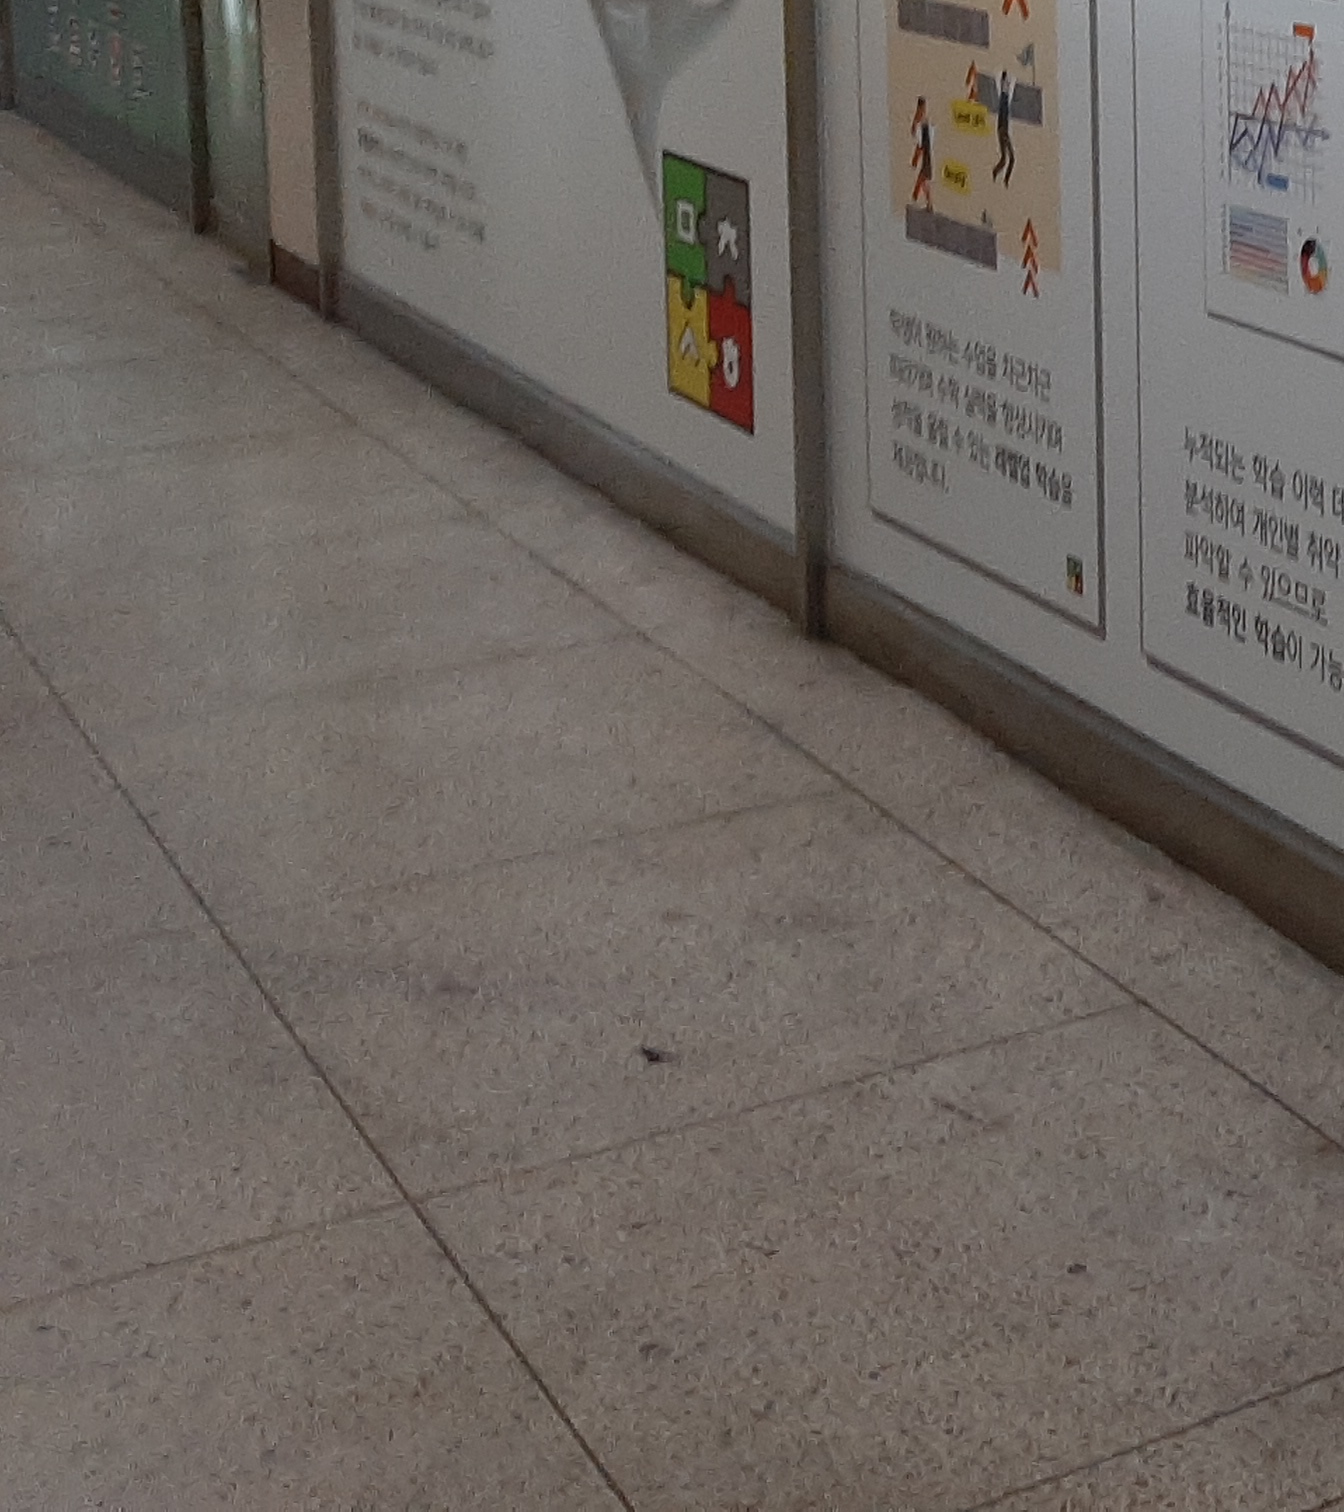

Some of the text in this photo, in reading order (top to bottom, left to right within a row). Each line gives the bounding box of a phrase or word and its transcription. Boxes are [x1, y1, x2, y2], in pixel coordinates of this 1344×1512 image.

[1184, 425, 1245, 485] 누적되는
[1252, 453, 1286, 501] 학습
[1292, 468, 1325, 517] 이력
[1184, 478, 1245, 536] 분석하여
[1253, 508, 1300, 561] 개인별
[1307, 530, 1340, 578] 취약
[1238, 557, 1254, 591] 수
[1185, 580, 1247, 643] 효율적인
[1254, 613, 1302, 670] 학습이
